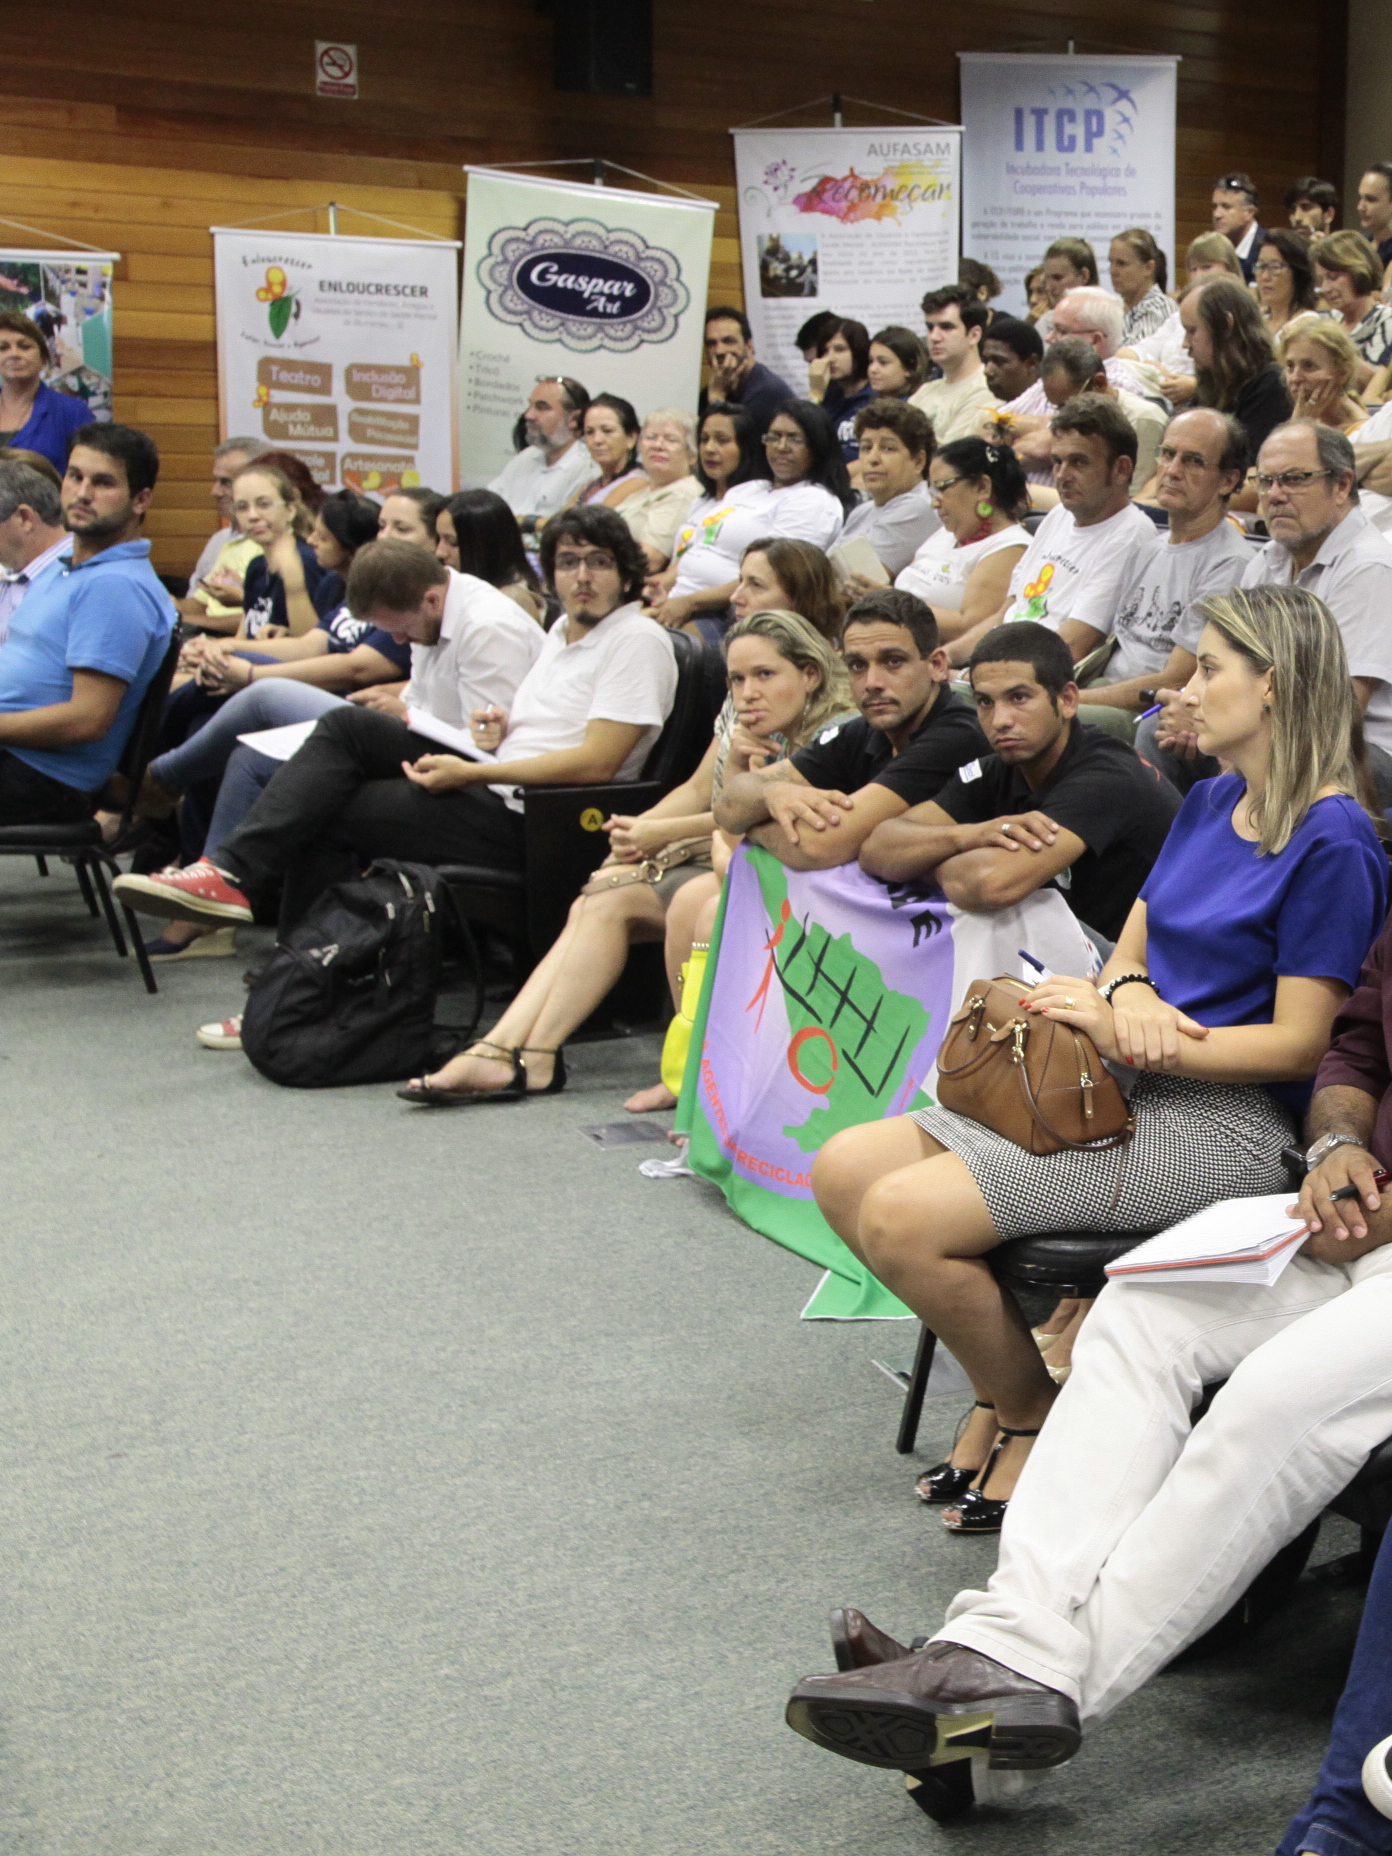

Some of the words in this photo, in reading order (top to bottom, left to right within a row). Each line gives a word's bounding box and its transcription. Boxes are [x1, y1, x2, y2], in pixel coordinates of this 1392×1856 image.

[1014, 107, 1105, 153] ITCP
[867, 142, 951, 157] AUFASAM
[1123, 163, 1137, 178] de
[529, 261, 638, 298] Gaspar
[318, 280, 429, 297] ENLOUCRESCER
[586, 295, 622, 314] Art
[270, 365, 322, 388] Teatro
[352, 369, 407, 385] Inclusão
[371, 384, 416, 401] Digital
[269, 408, 311, 425] Ajuda
[288, 423, 335, 438] Mútua
[588, 814, 598, 825] A
